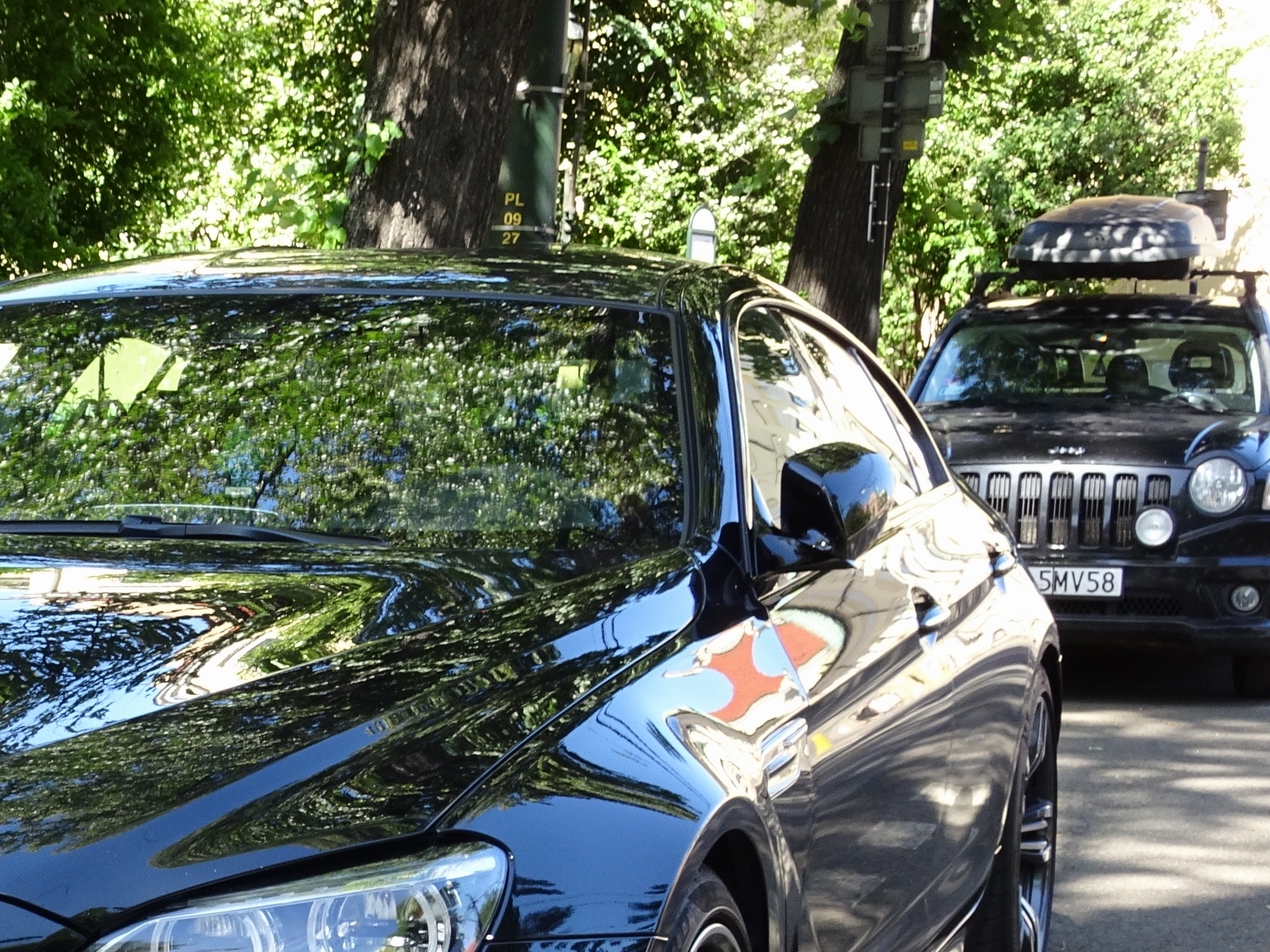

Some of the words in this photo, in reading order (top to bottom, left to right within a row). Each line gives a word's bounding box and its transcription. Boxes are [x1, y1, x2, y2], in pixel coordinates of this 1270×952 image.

[504, 192, 525, 207] PL
[503, 211, 522, 226] 09
[501, 231, 521, 245] 27
